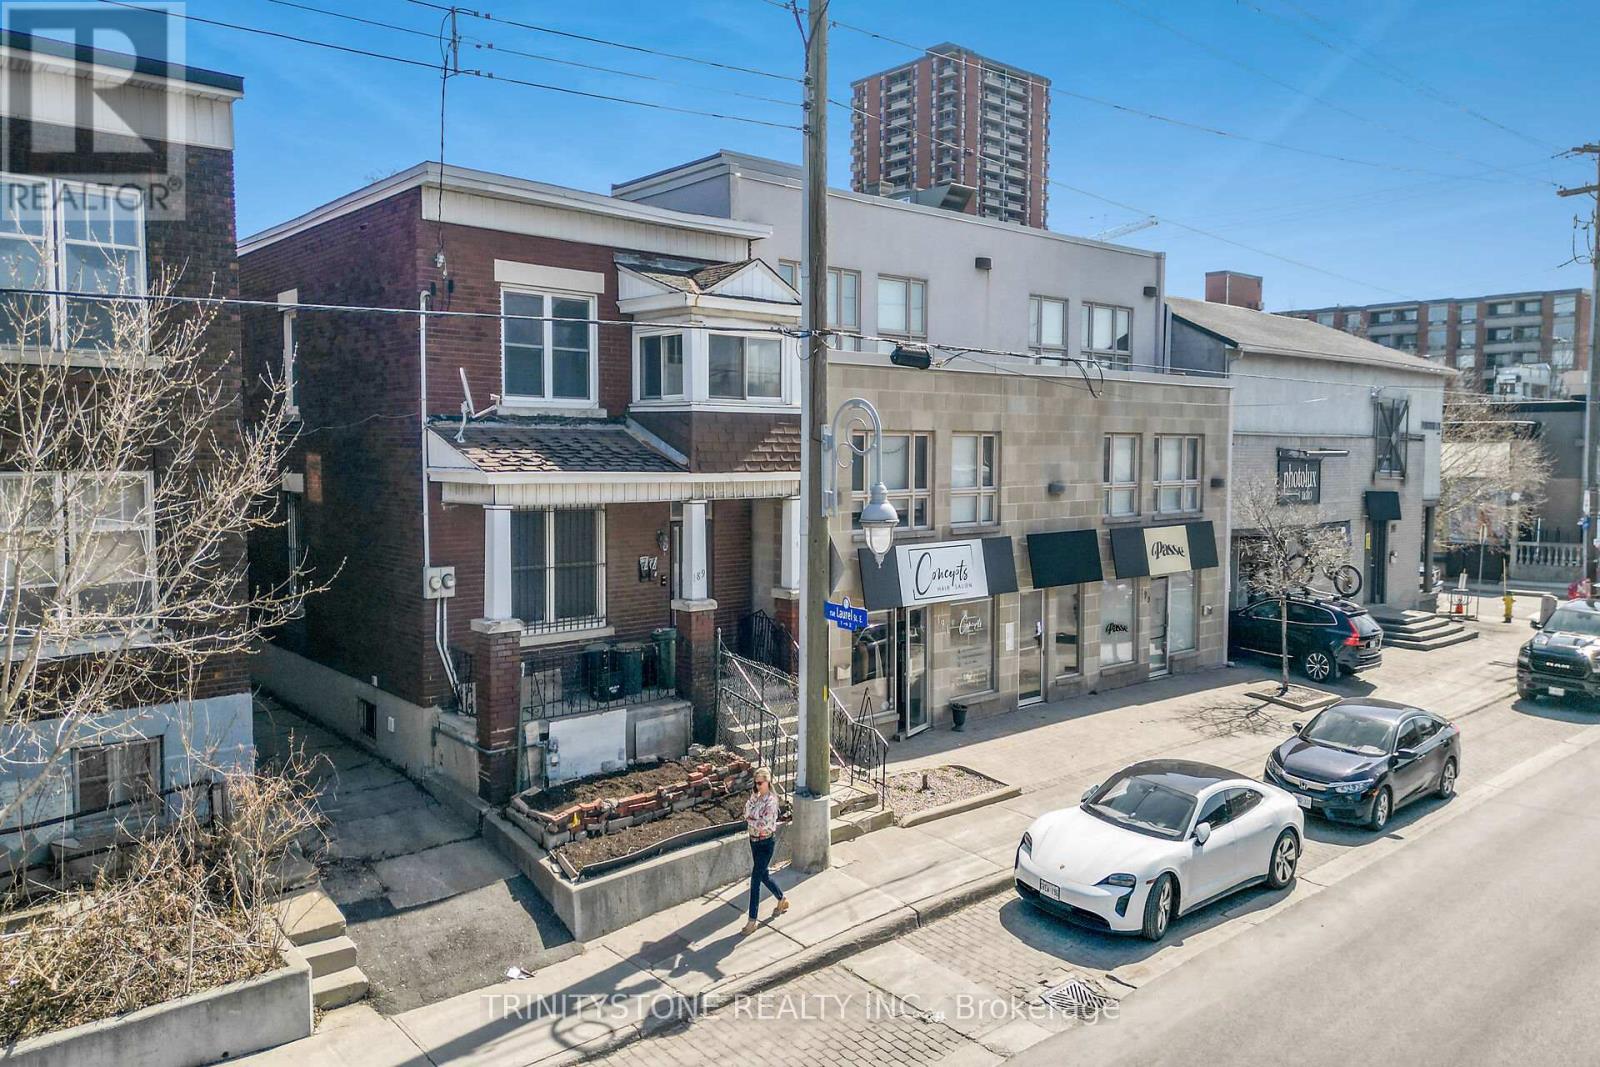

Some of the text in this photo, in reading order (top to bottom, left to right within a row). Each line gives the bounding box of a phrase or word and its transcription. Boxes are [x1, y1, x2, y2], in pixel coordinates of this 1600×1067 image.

[1283, 463, 1317, 495] photolux
[915, 552, 968, 595] Concepts
[836, 607, 853, 621] Laurel
[1545, 661, 1570, 669] RAM
